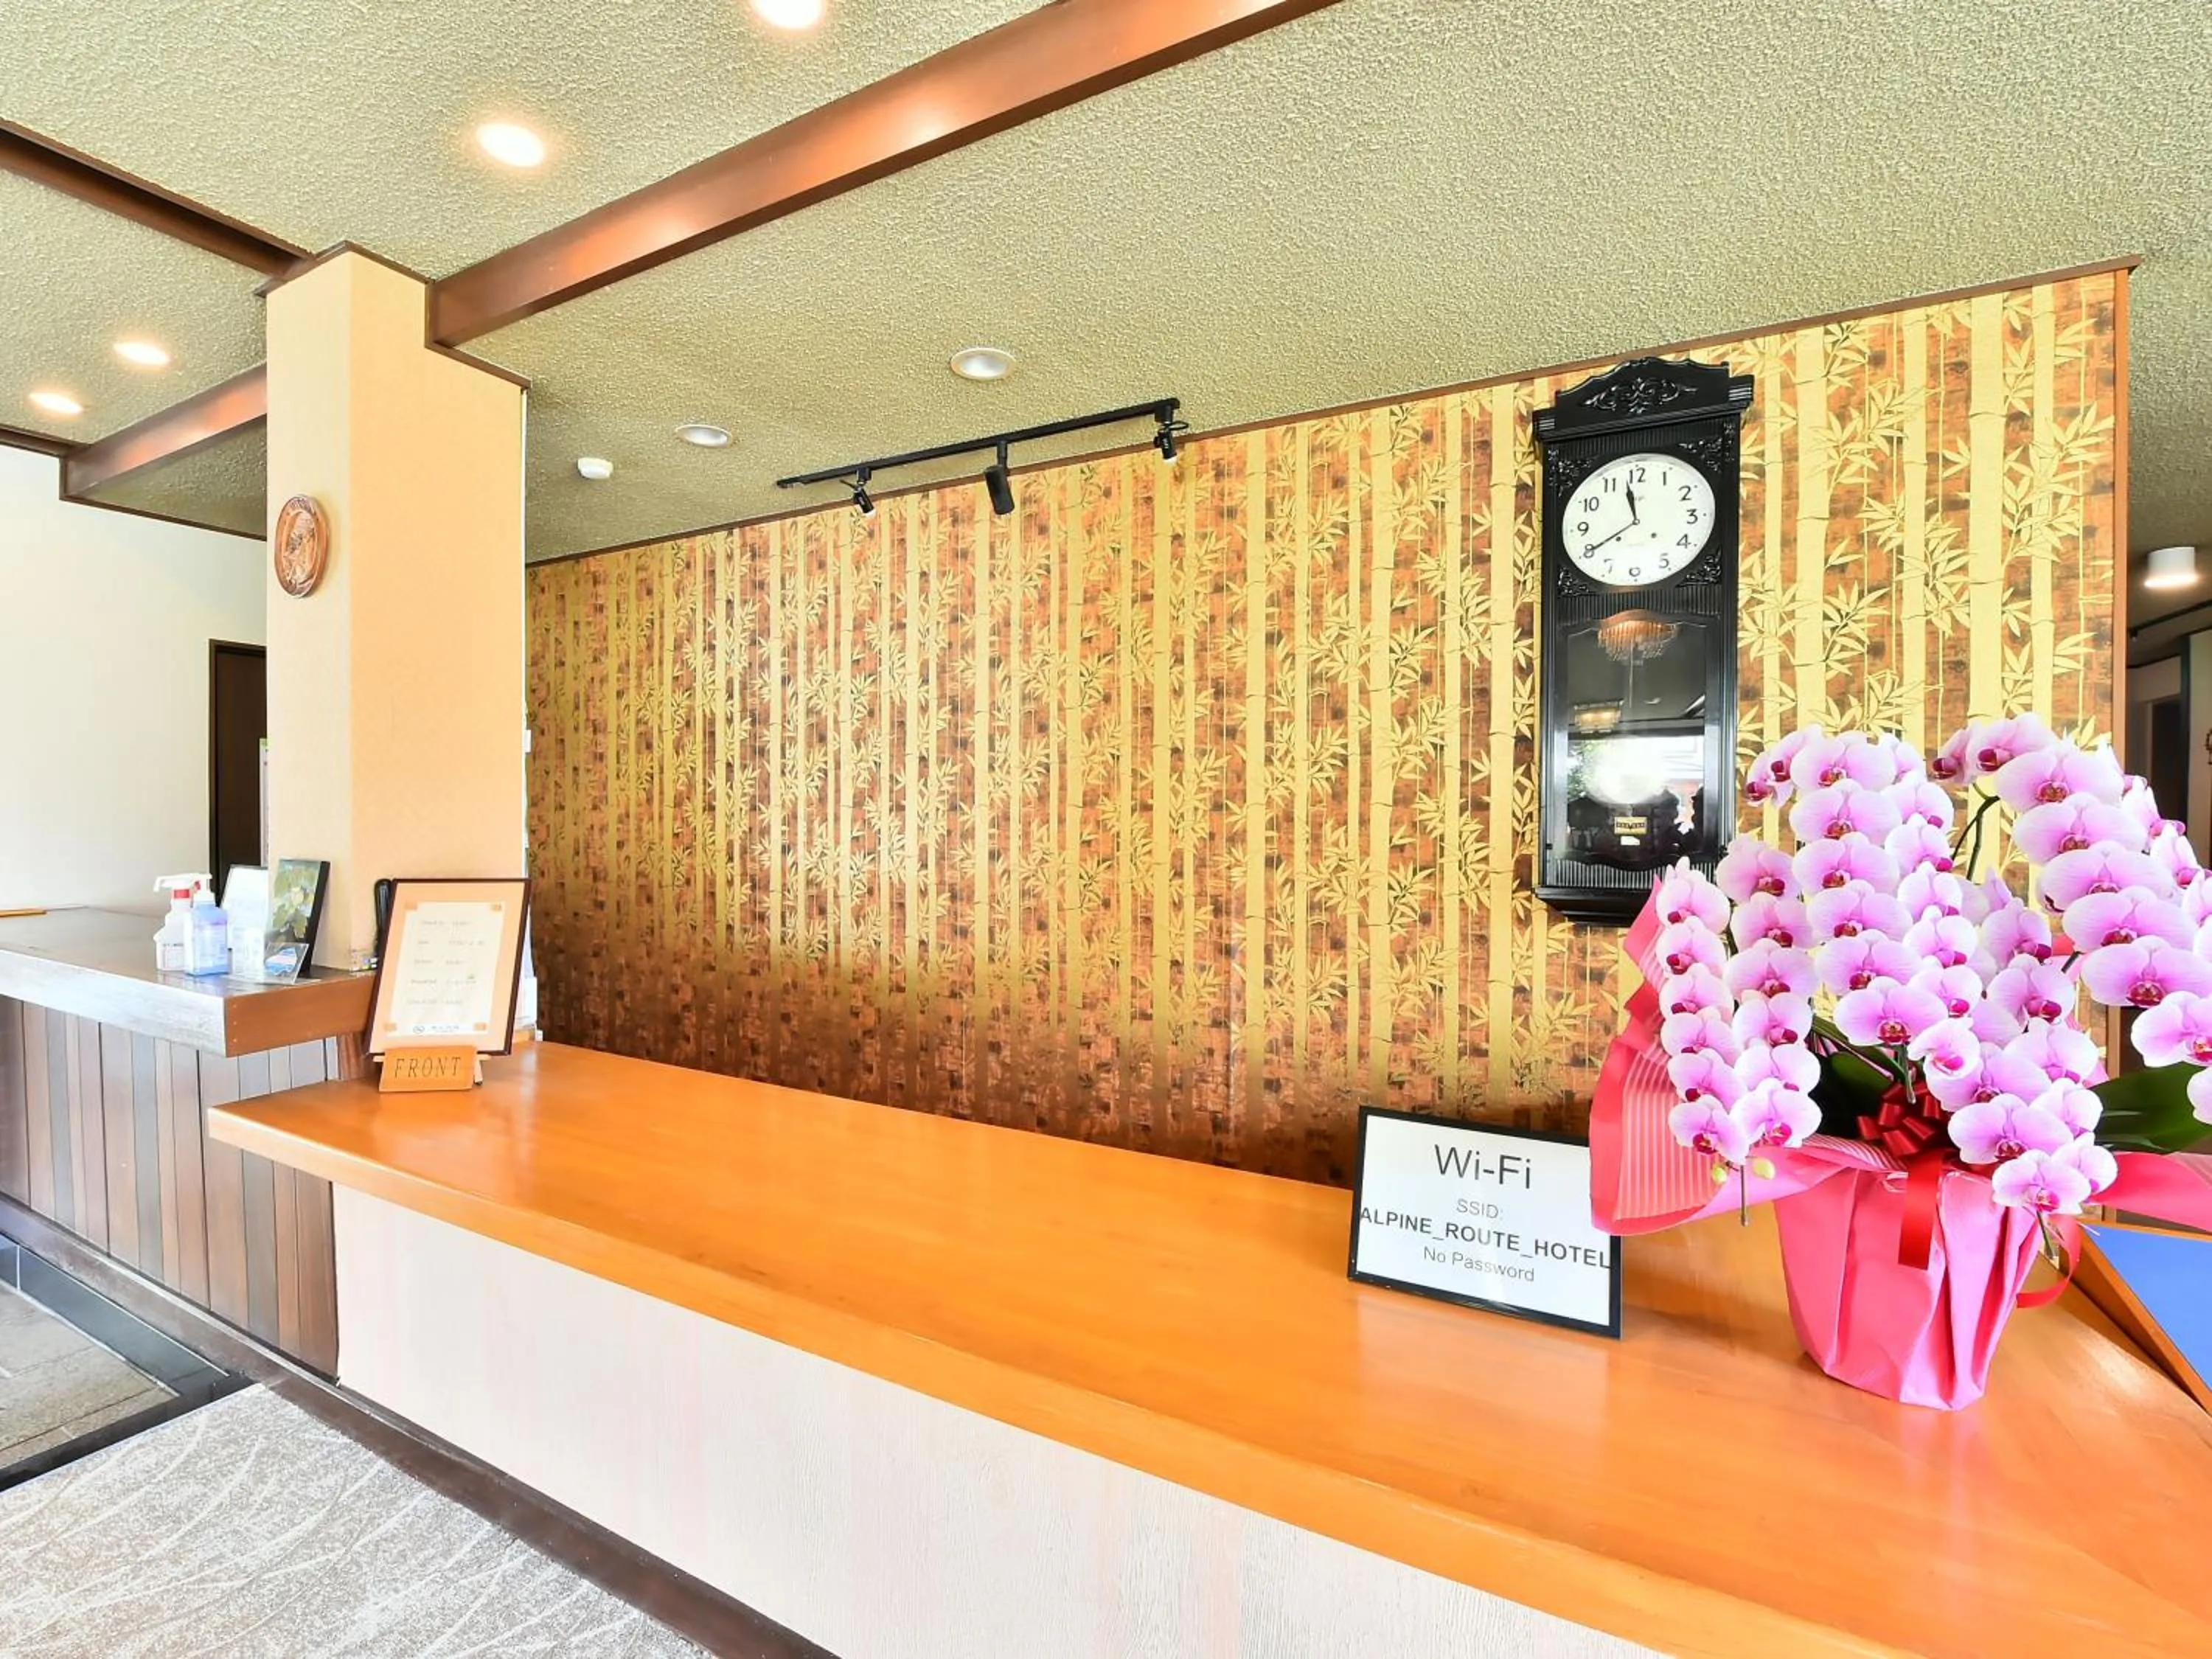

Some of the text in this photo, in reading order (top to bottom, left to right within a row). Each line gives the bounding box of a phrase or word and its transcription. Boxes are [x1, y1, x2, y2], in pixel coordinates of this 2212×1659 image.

[1629, 467, 1646, 484] 12
[1662, 471, 1667, 486] 1
[1604, 478, 1616, 493] 11
[1678, 485, 1691, 501] 2
[1583, 496, 1599, 512] 10
[1686, 508, 1698, 524] 3
[1577, 521, 1589, 537] 9
[1676, 534, 1691, 549] 4
[1583, 543, 1594, 558] 8
[1603, 558, 1613, 574] 7
[1659, 553, 1669, 568] 5
[394, 1057, 461, 1078] FRONT
[1435, 1144, 1531, 1189] Wi-Fi
[1456, 1198, 1503, 1219] SSID:
[1360, 1207, 1610, 1269] ALPINE_ROUTE_HOTEL
[1423, 1246, 1534, 1282] No Password
